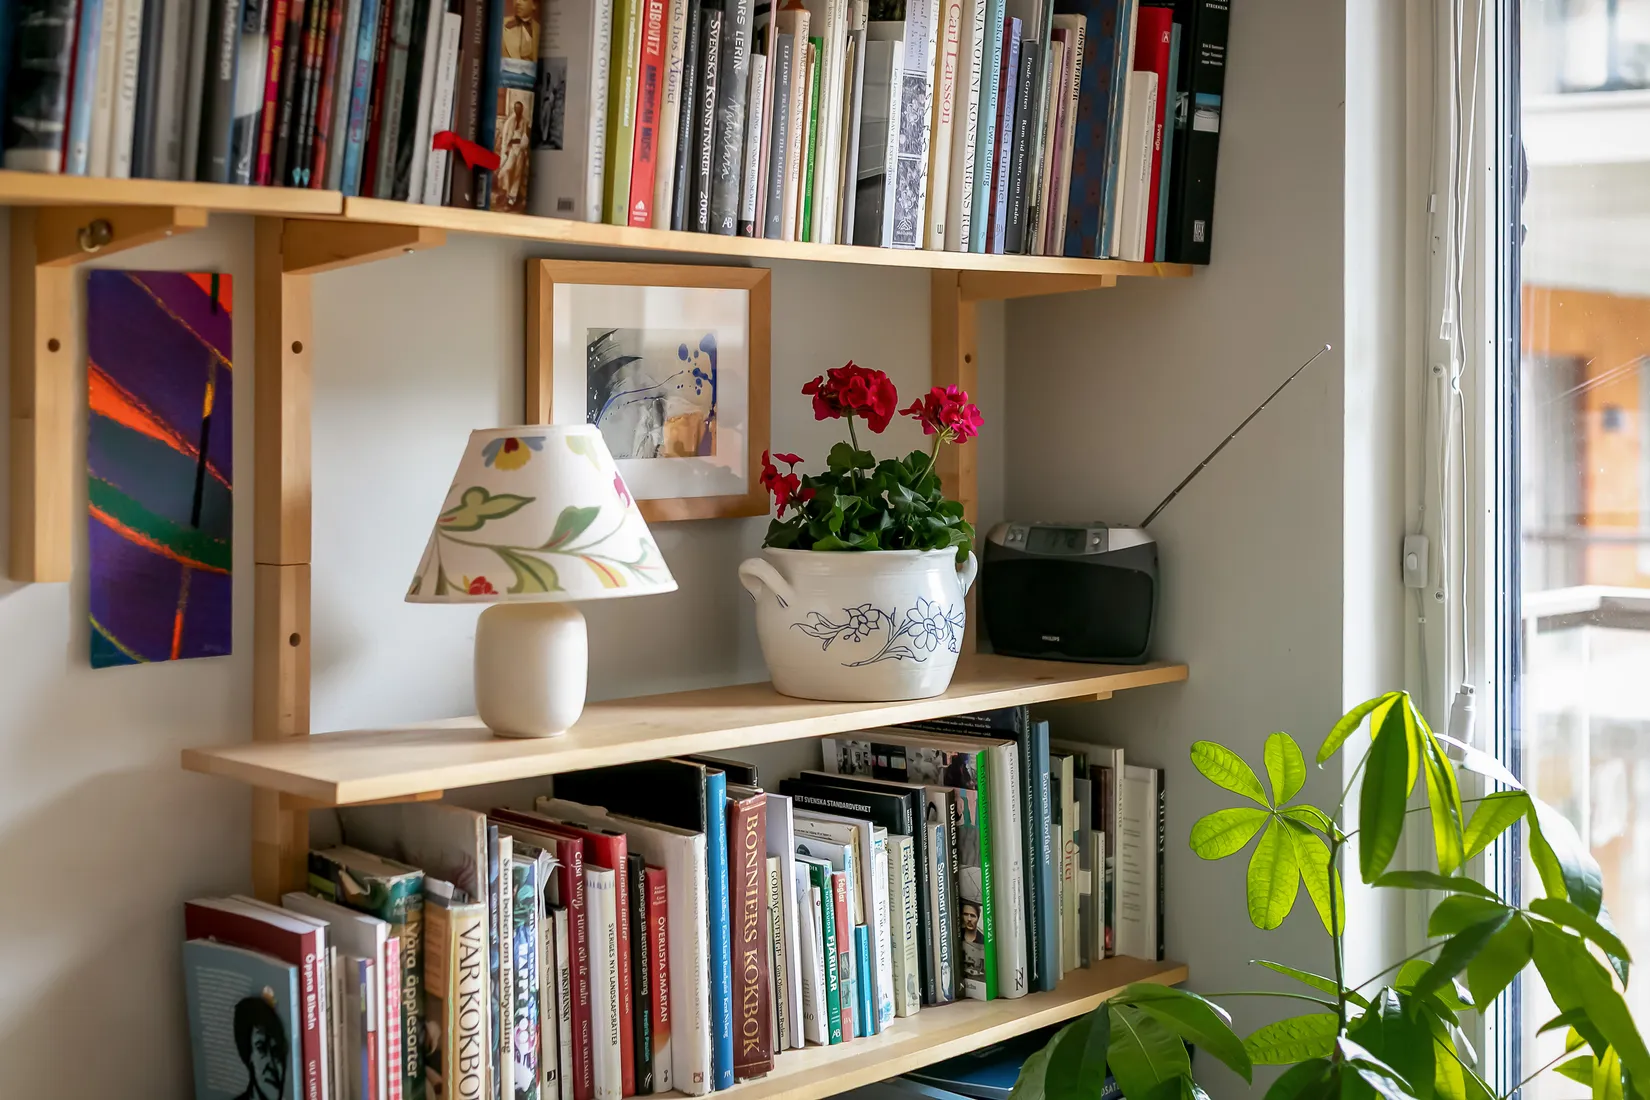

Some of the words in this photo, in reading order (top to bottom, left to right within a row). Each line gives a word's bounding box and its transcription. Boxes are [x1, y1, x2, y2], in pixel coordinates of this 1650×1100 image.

[646, 0, 663, 56] EIBOVITZ
[671, 25, 683, 51] hos
[947, 4, 962, 43] Carl
[1075, 27, 1085, 57] GÖSTA
[706, 20, 720, 79] SVENSKA
[733, 31, 744, 70] LERIN
[971, 37, 982, 93] NOTINI
[1025, 57, 1034, 78] Frode
[598, 57, 607, 82] OM
[666, 54, 682, 105] Monet
[942, 52, 958, 124] Larsson
[1073, 59, 1083, 101] WERNER
[642, 64, 658, 123] AMERICAN
[1021, 80, 1031, 110] Grytten
[986, 125, 996, 144] Ewa
[1003, 93, 1014, 144] svenska
[1020, 119, 1028, 137] Rum
[1155, 124, 1163, 150] Sverige
[640, 127, 653, 164] MUSIC
[751, 135, 760, 168] GUNNAR
[963, 102, 978, 209] KONSTNÄRENS
[1016, 153, 1025, 176] havet,
[1018, 139, 1026, 151] vid
[983, 150, 994, 186] Rudling
[998, 149, 1010, 204] rummet
[1015, 178, 1023, 193] rum
[699, 191, 709, 224] 2008
[748, 168, 758, 213] BRUSEWITZ
[961, 213, 971, 246] RUM
[1013, 200, 1021, 225] staden
[804, 796, 826, 806] SVENSKA
[826, 800, 871, 813] STANDARDVERKET
[1009, 753, 1017, 823] NATIONALNYCKELN
[1041, 772, 1050, 815] Europas
[1042, 817, 1052, 865] Rovfåglar
[502, 858, 512, 897] Stora
[571, 852, 583, 878] Cajsa
[618, 856, 627, 905] Italienska
[639, 870, 646, 881] 50
[743, 813, 761, 942] BONNIERS
[637, 883, 647, 919] genvägar
[769, 871, 779, 914] GODDAG
[837, 879, 846, 902] Fåglar
[902, 846, 915, 940] Fågelguiden
[936, 863, 947, 910] Svampar
[983, 862, 992, 914] Jubileum
[503, 898, 512, 941] boken
[719, 893, 727, 922] Ahlberg
[406, 922, 420, 969] Våra
[576, 913, 587, 944] Hiram
[657, 917, 668, 970] ÖVERLISTA
[939, 919, 950, 960] naturen
[985, 918, 994, 942] 2021
[459, 921, 485, 984] VÅR
[503, 943, 511, 964] om
[518, 943, 529, 1000] HAPPY
[578, 946, 588, 962] och
[579, 965, 588, 975] de
[639, 933, 650, 995] fettförbränning
[827, 936, 838, 991] FJÄRILAR
[304, 954, 316, 993] Öppna
[579, 979, 589, 1007] andra
[721, 961, 729, 994] Rundquist
[306, 994, 317, 1030] Bibeln
[500, 968, 514, 1054] hobbyodling
[609, 976, 618, 1045] LANDSKAPSRÄTTER
[659, 973, 669, 1022] SMÄRTAN
[743, 950, 761, 1057] KOKBOK
[403, 975, 420, 1079] äpplesorter
[722, 1014, 730, 1038] Nyberg
